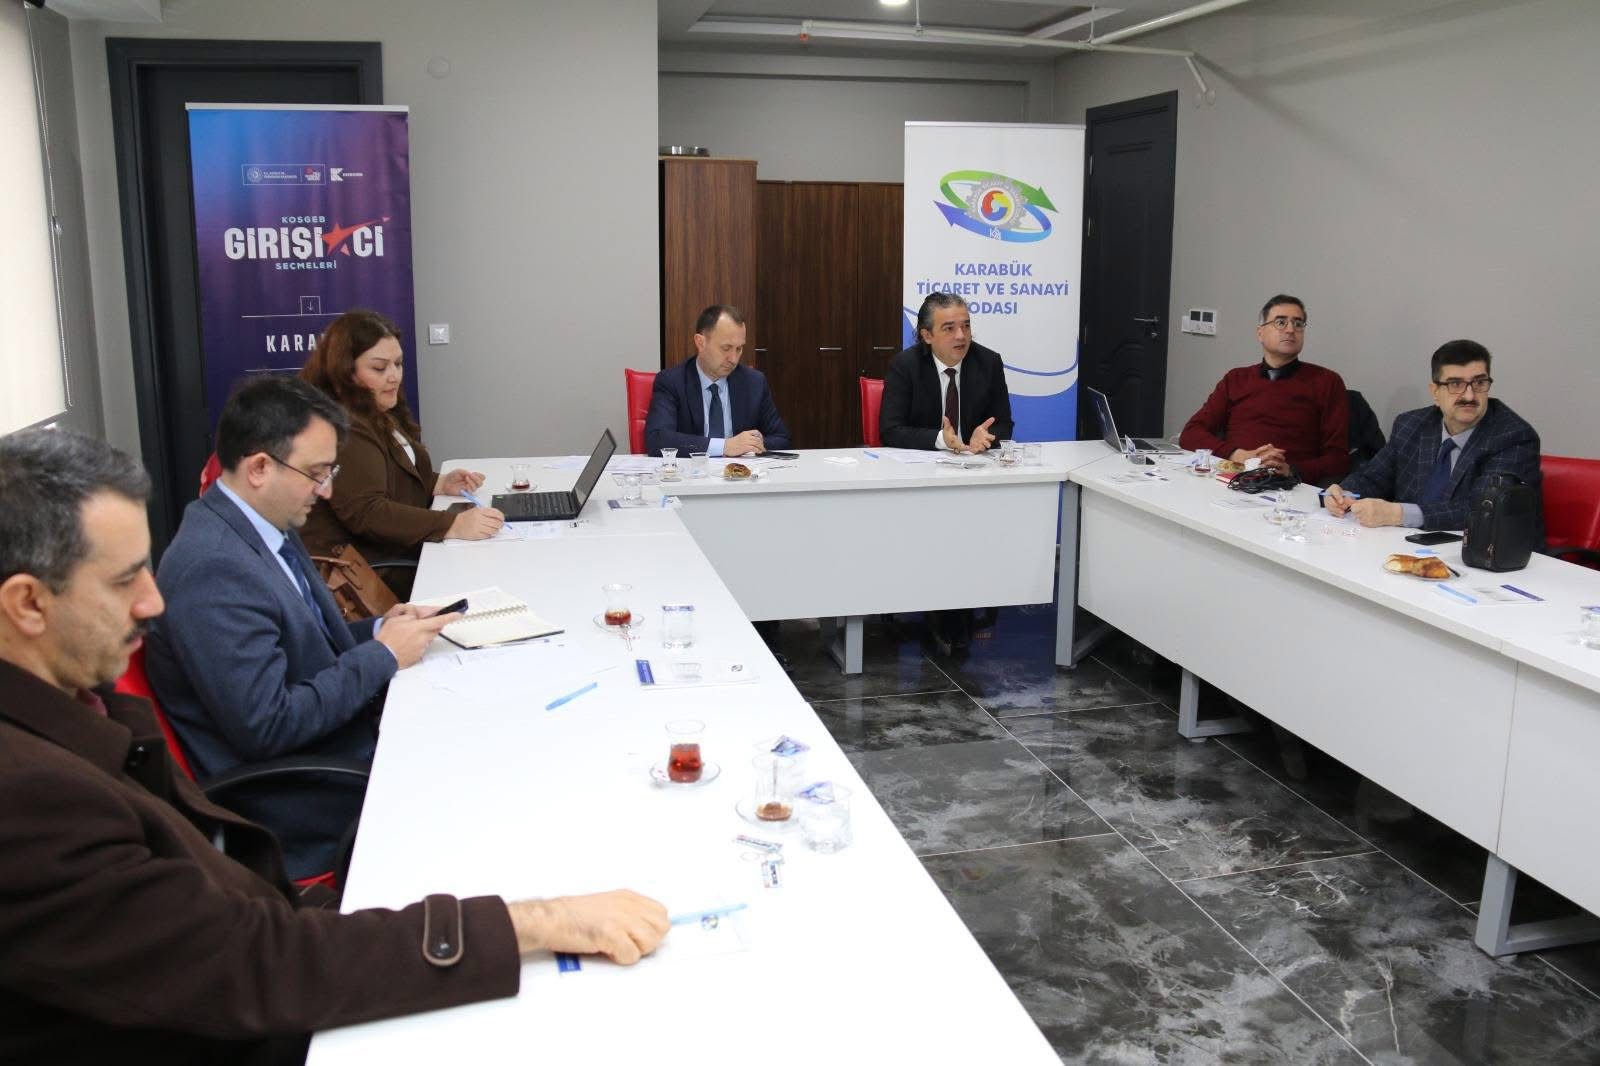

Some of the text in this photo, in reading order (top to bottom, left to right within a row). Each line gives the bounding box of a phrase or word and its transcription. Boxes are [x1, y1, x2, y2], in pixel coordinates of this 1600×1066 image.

[955, 260, 1033, 276] KARABÜK
[916, 279, 1069, 296] TİCARET VE SANAYİ
[969, 302, 1018, 314] ODASI
[266, 333, 325, 353] KARA
